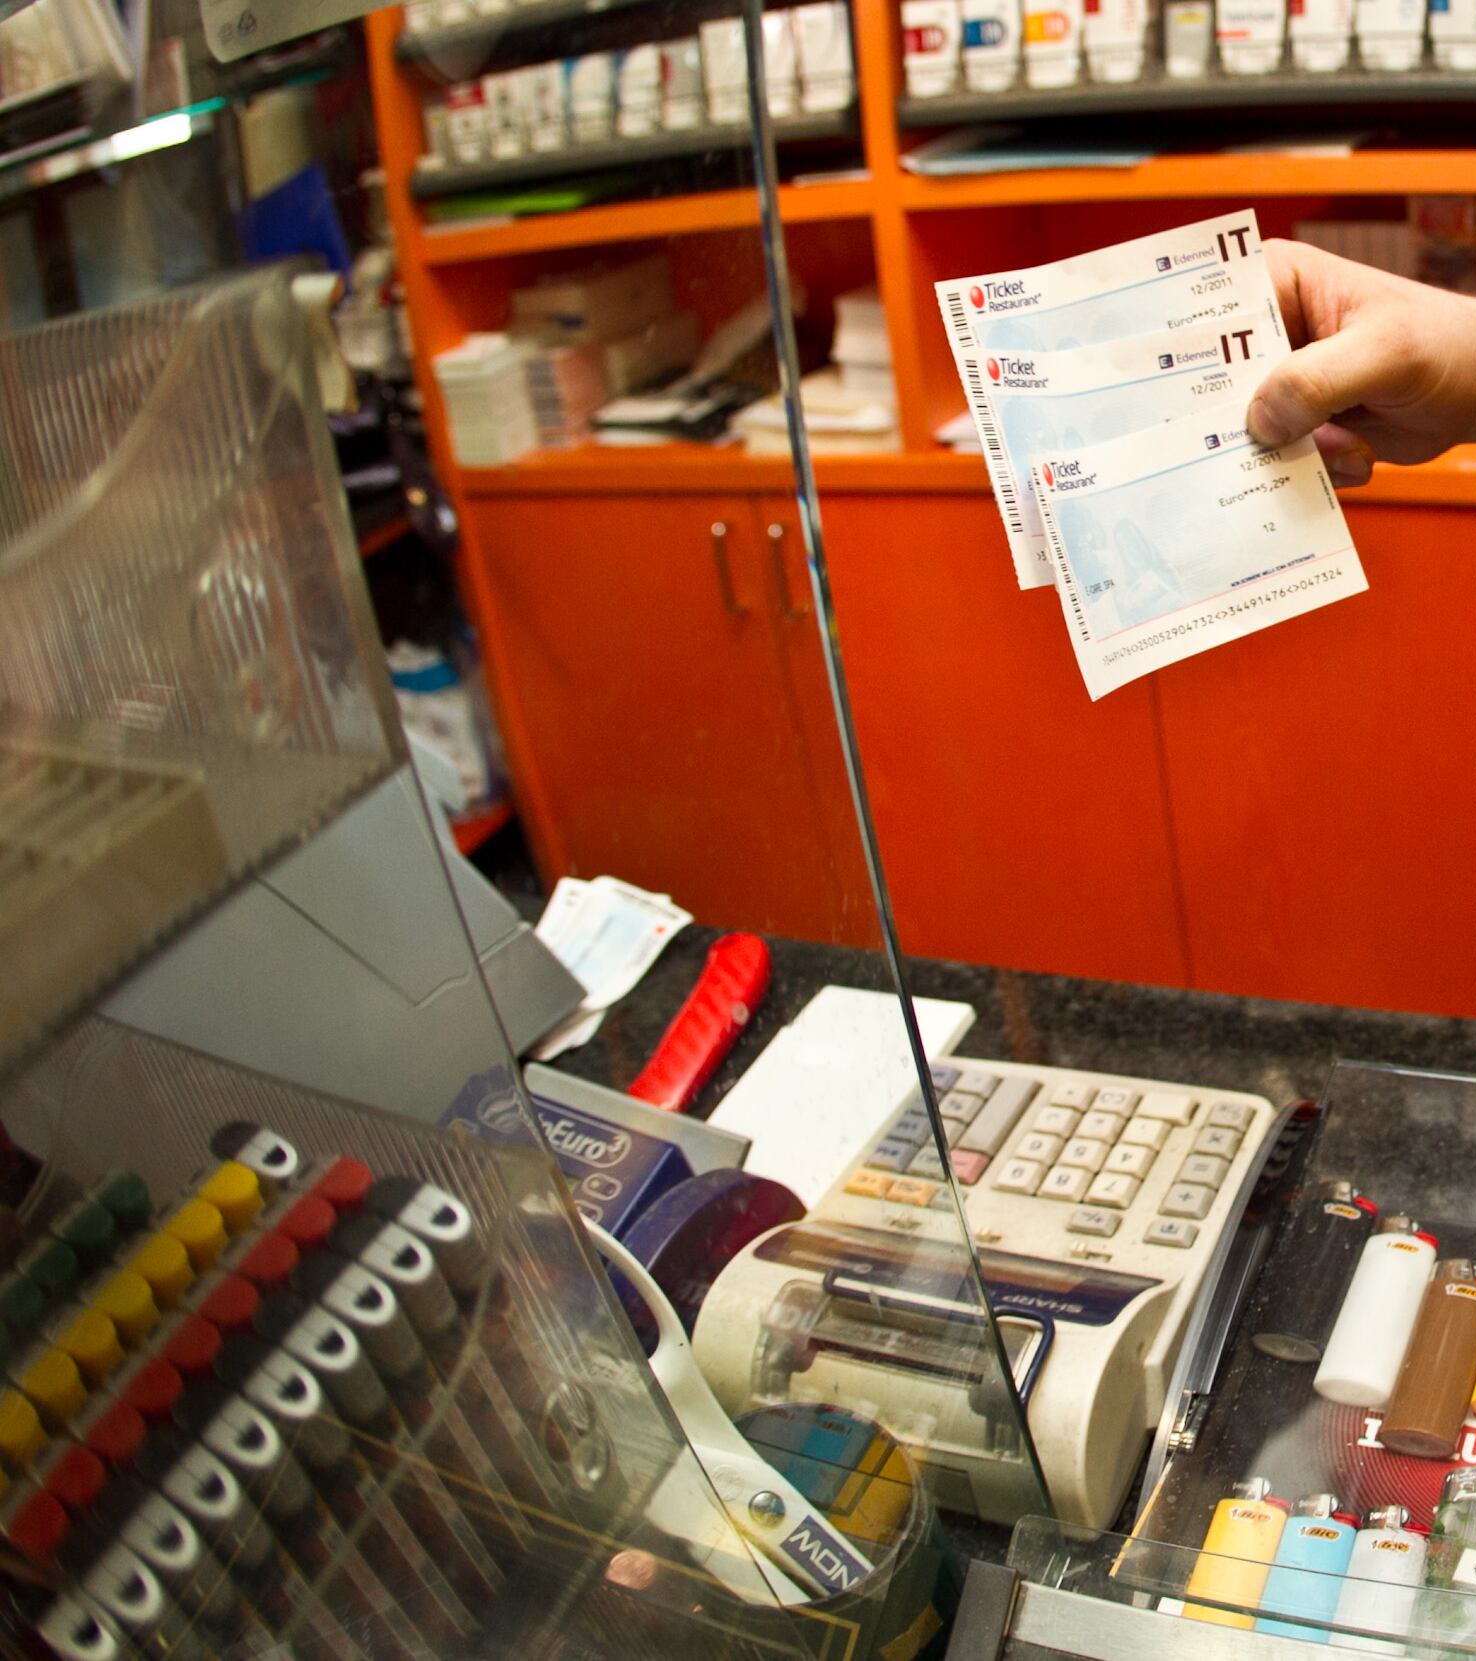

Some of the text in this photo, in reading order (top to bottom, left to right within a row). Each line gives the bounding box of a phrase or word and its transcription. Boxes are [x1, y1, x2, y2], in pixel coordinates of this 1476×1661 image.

[1217, 226, 1250, 262] IT
[1173, 246, 1215, 265] Edenred
[984, 280, 1025, 299] Ticket
[1191, 277, 1233, 295] 12/2011
[1176, 347, 1217, 363] Edenred
[1220, 329, 1253, 364] IT
[1000, 358, 1035, 375] Ticket
[1191, 378, 1233, 395] 12/2011
[1050, 460, 1082, 478] Ticket
[1240, 451, 1282, 472] 12/2011
[1263, 521, 1277, 534] 12
[1002, 1294, 1084, 1314] SHARP
[788, 1527, 860, 1590] NOW
